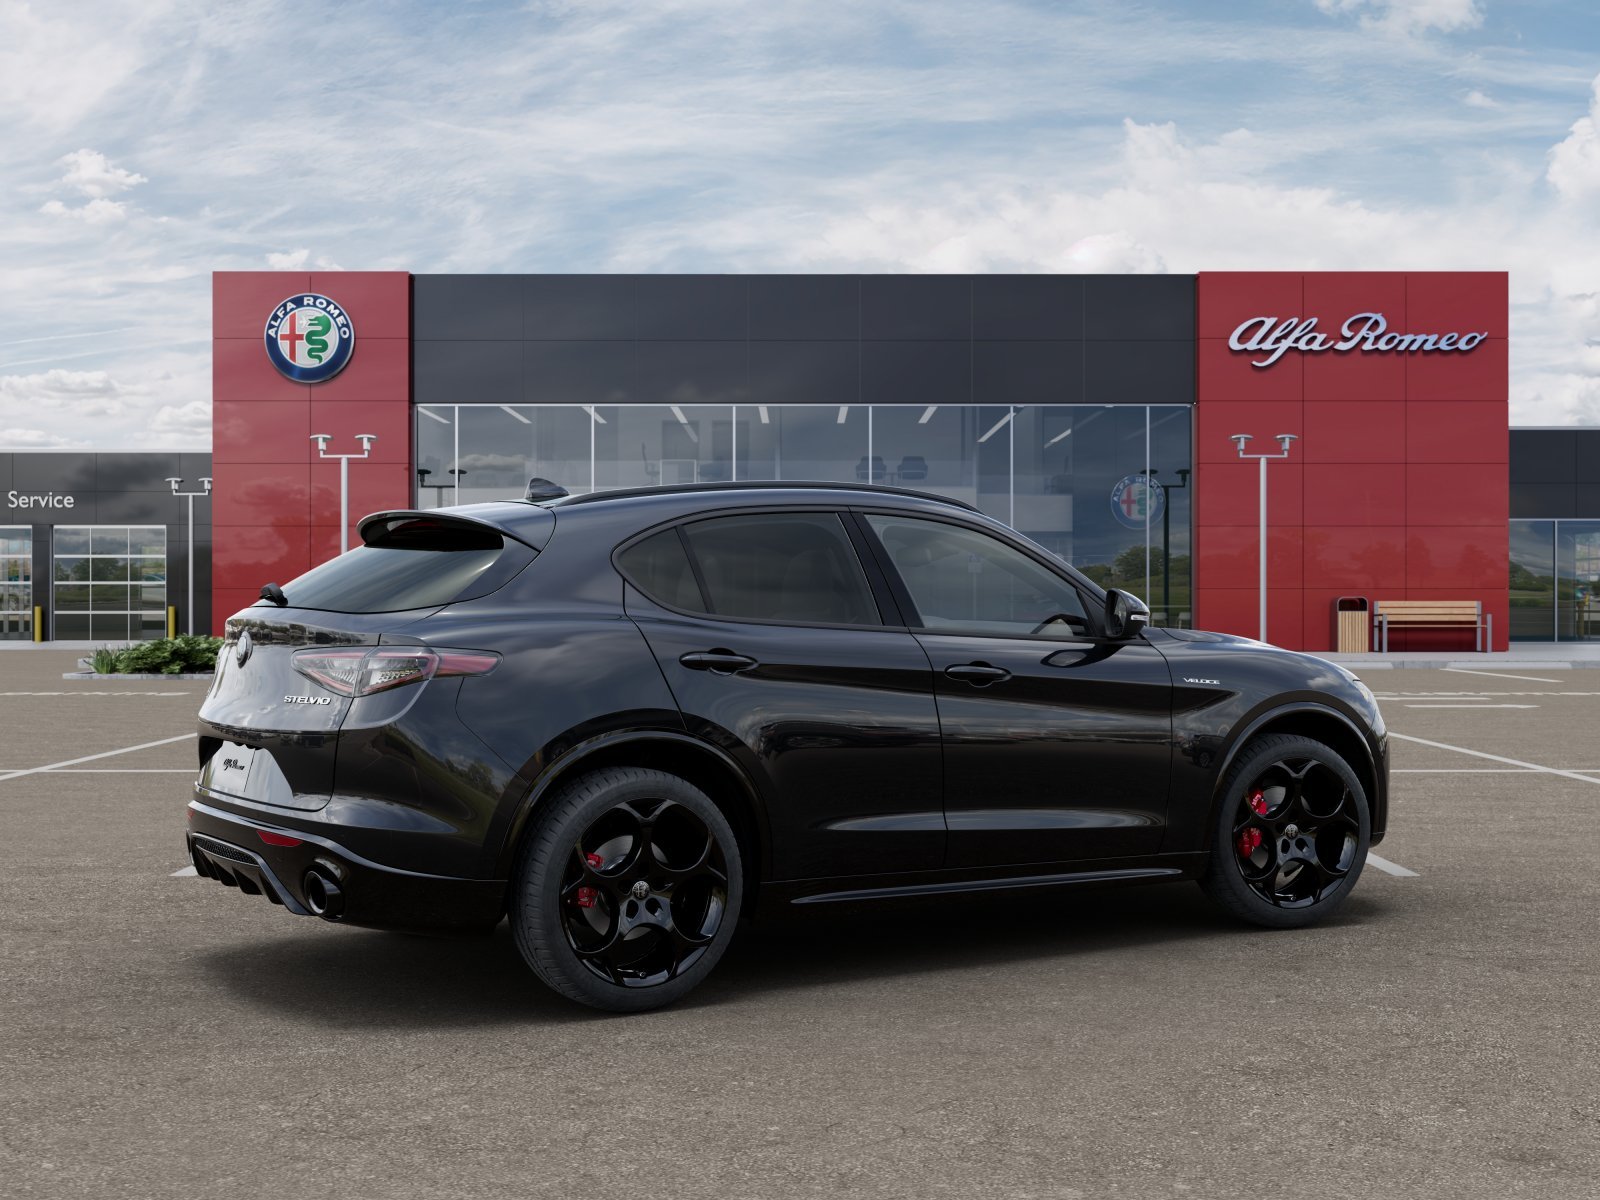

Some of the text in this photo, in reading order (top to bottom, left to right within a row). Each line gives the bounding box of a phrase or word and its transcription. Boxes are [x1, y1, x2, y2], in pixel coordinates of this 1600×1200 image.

[268, 296, 350, 339] ALFA ROMEO
[1228, 312, 1489, 367] Alfa Romeo
[7, 490, 75, 508] Service
[283, 695, 331, 705] STELVIO
